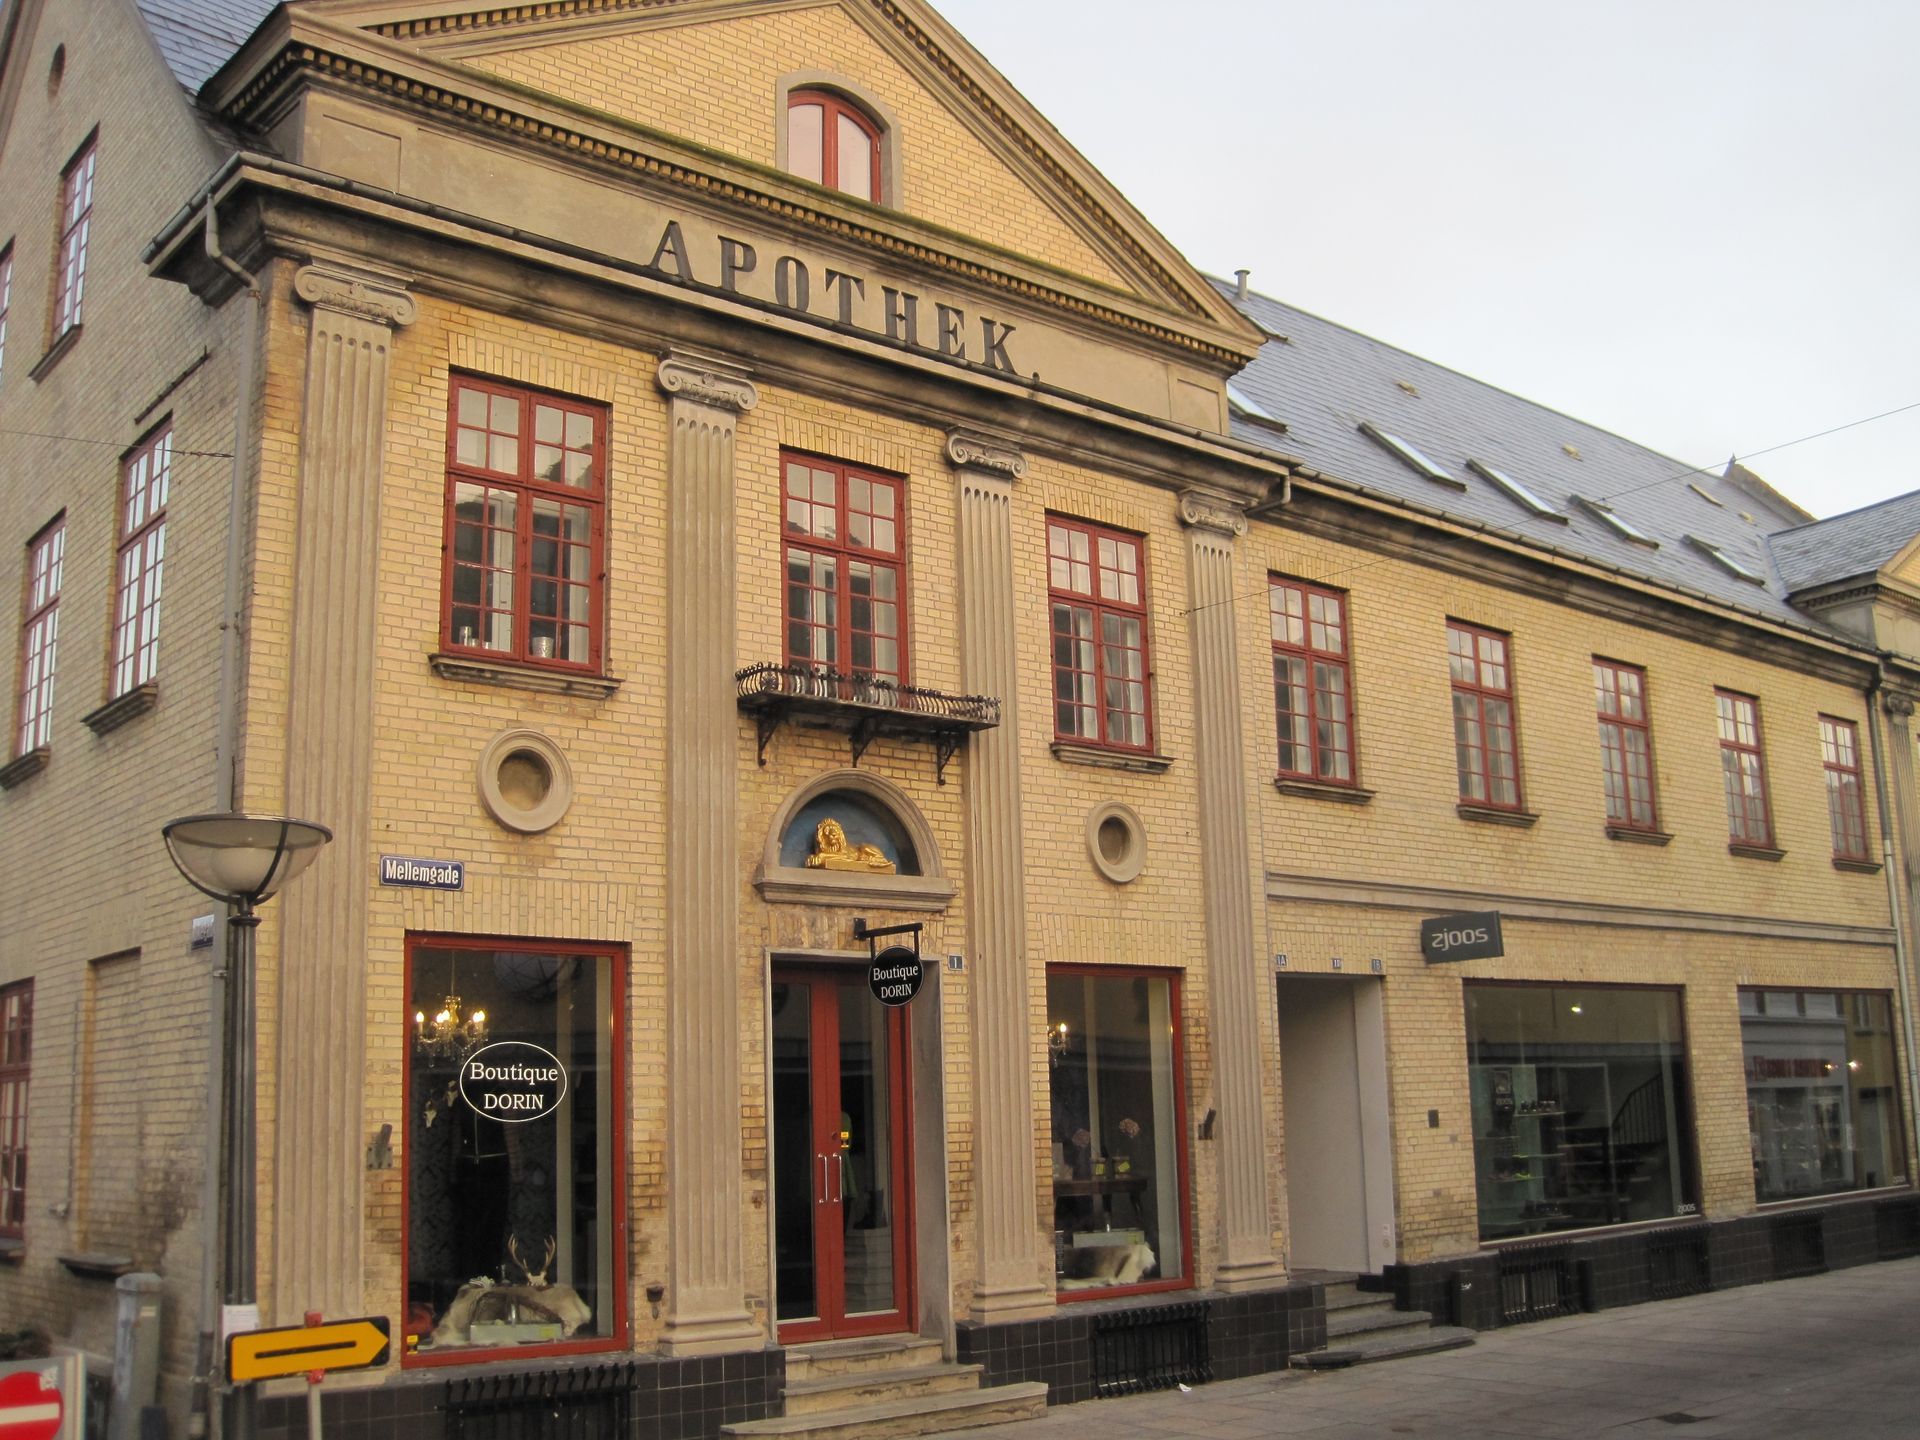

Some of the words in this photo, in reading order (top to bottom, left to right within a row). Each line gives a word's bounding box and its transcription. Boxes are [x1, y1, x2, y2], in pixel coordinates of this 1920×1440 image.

[386, 860, 459, 885] Mellemgade
[1431, 928, 1488, 951] zjoos
[873, 964, 918, 981] Boutique
[881, 983, 912, 998] DORIN
[470, 1062, 558, 1085] Boutique
[484, 1093, 544, 1109] DORIN
